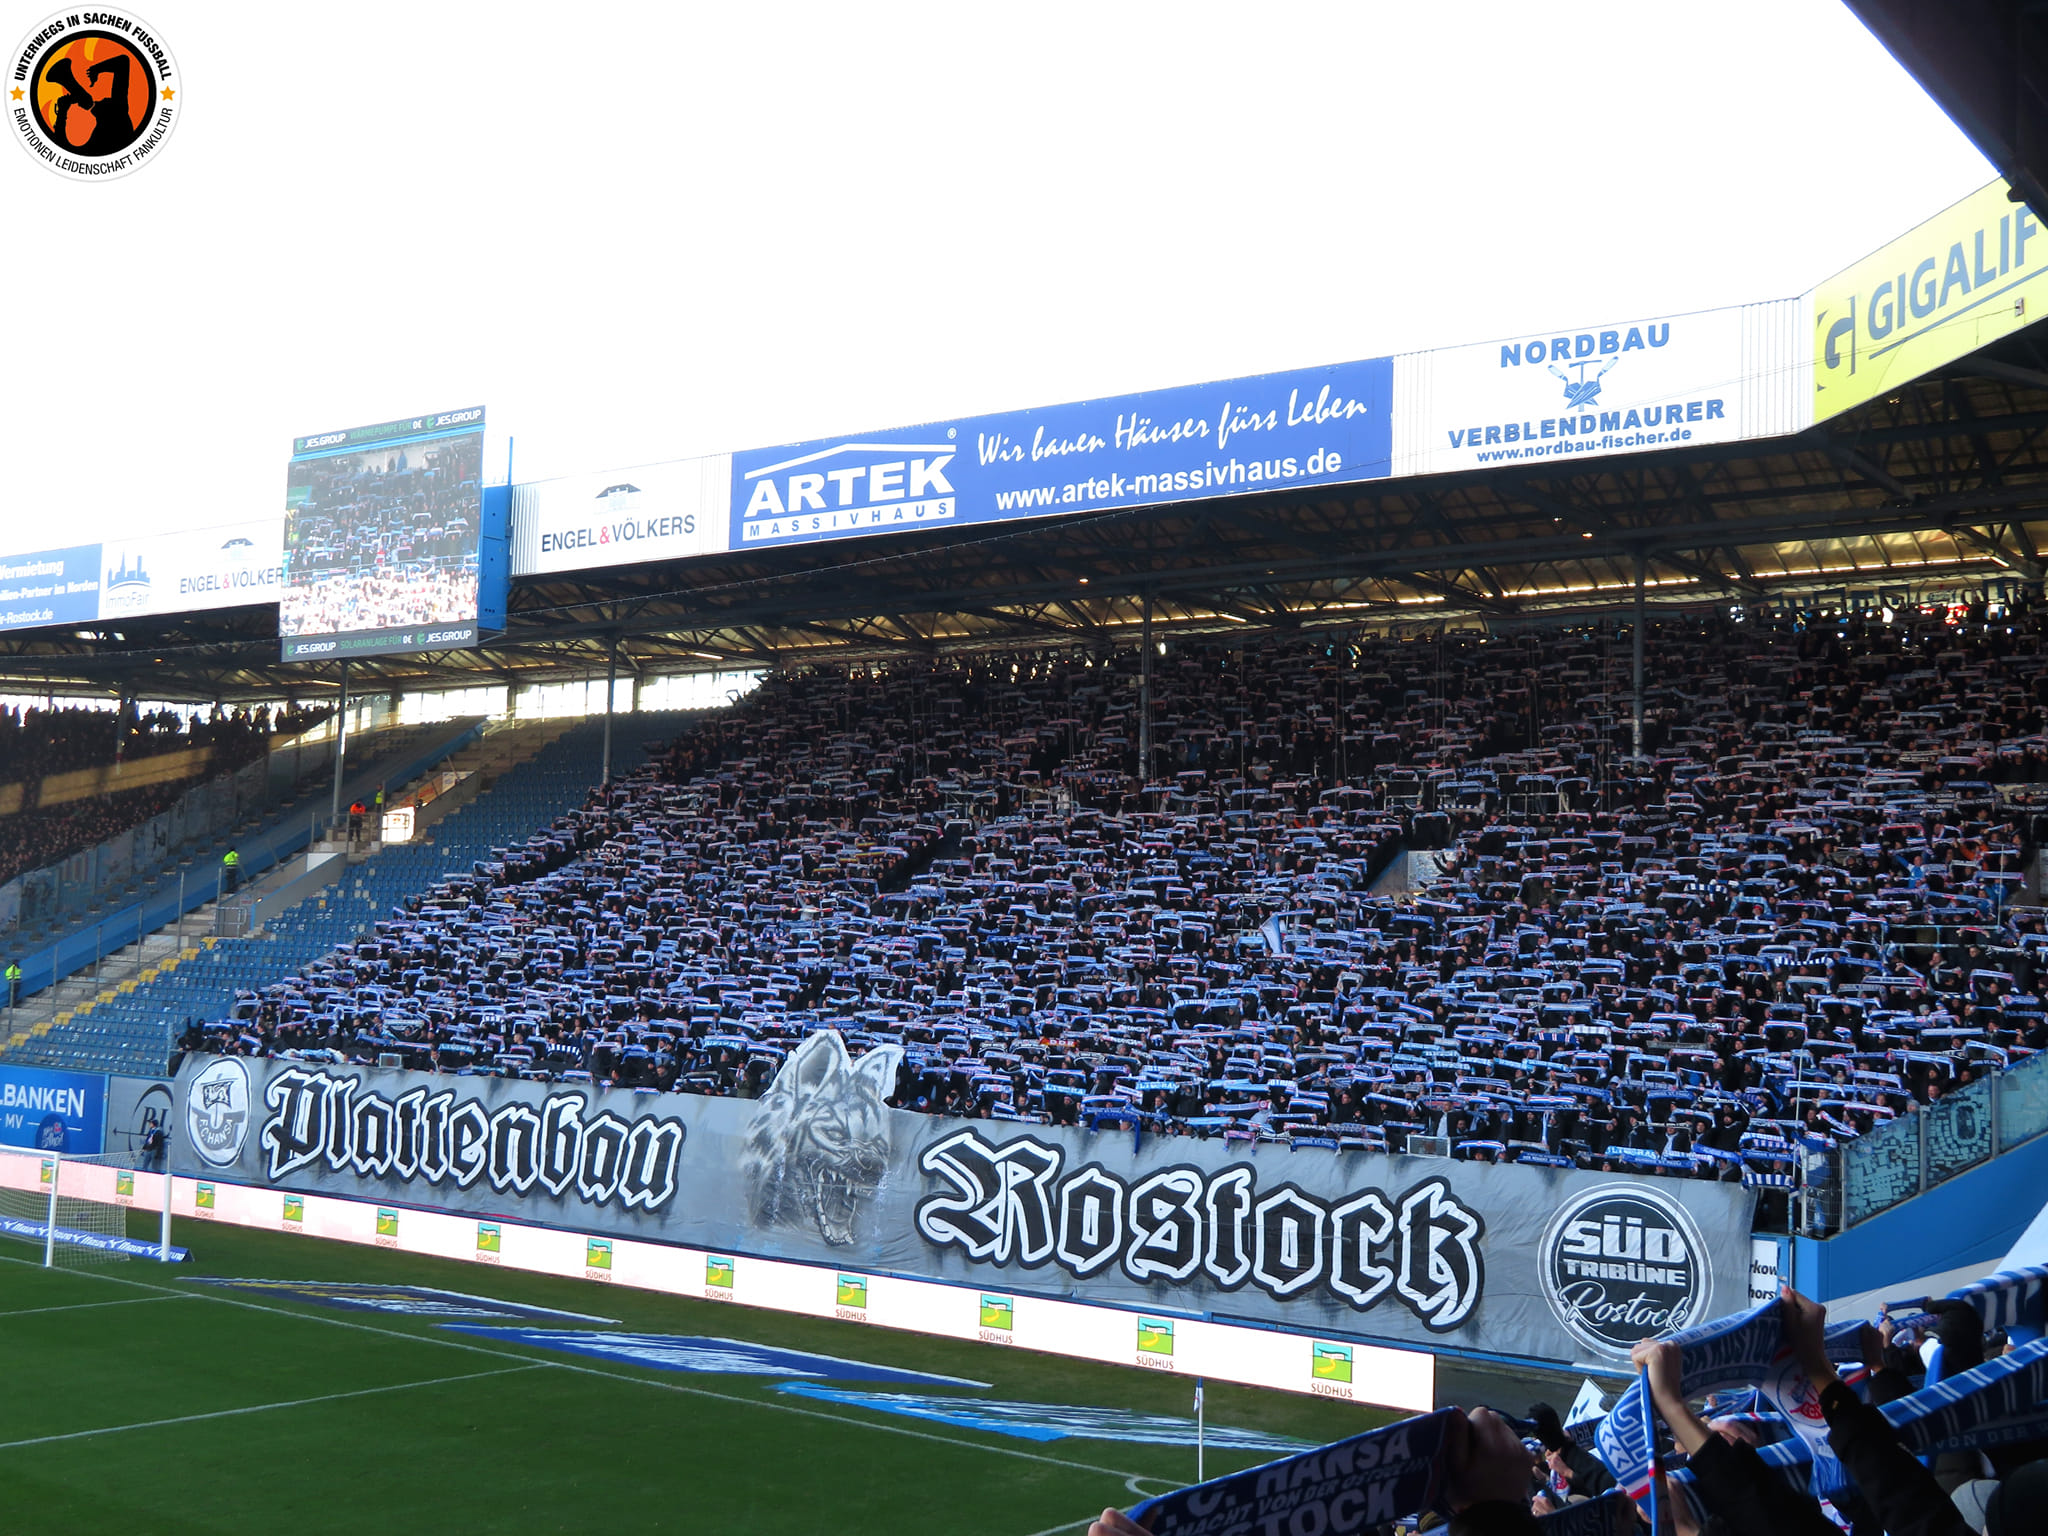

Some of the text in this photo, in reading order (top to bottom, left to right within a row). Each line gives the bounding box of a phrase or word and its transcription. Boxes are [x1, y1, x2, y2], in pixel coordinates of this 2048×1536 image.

[1500, 323, 1670, 368] NORDBAU
[304, 433, 346, 448] JES.GROUP
[435, 410, 482, 427] JES.GROUP
[977, 384, 1367, 466] Wir bauen Häuser fürs Leben
[1448, 399, 1725, 448] VERBLENDMAURER
[1477, 427, 1692, 462] www.nordbau-fischer.de
[744, 454, 955, 518] ARTEK
[995, 448, 1342, 510] www.artek-massivhaus.de
[541, 514, 695, 553] ENGEL & VÖLKERS
[750, 503, 947, 537] MASSIVHAUS
[0, 560, 64, 580] Vermietung
[67, 579, 98, 594] Norden
[180, 575, 220, 594] ENGEL
[223, 573, 230, 589] &
[294, 642, 336, 655] JES.GROUP
[425, 630, 472, 643] JES.GROUP
[0, 1083, 85, 1118] BANKEN
[5, 1113, 24, 1129] MV
[260, 1066, 688, 1215] Plattenbau
[914, 1125, 1486, 1334] Rostock
[1562, 1215, 1686, 1263] SÜD
[475, 1252, 500, 1264] SÜDHUS
[585, 1270, 612, 1281] SÜDHUS
[1562, 1258, 1686, 1287] TRIBÜNE
[704, 1288, 733, 1300] SÜDHUS
[1557, 1280, 1692, 1331] Rostock
[835, 1308, 867, 1321] SÜDHUS
[978, 1330, 1013, 1344] SÜDHUS
[1136, 1355, 1174, 1370] SÜDHUS
[1311, 1382, 1353, 1398] SÜDHUS
[1256, 1427, 1412, 1498] HANSA
[1258, 1489, 1302, 1515] VON
[1305, 1476, 1340, 1500] DER
